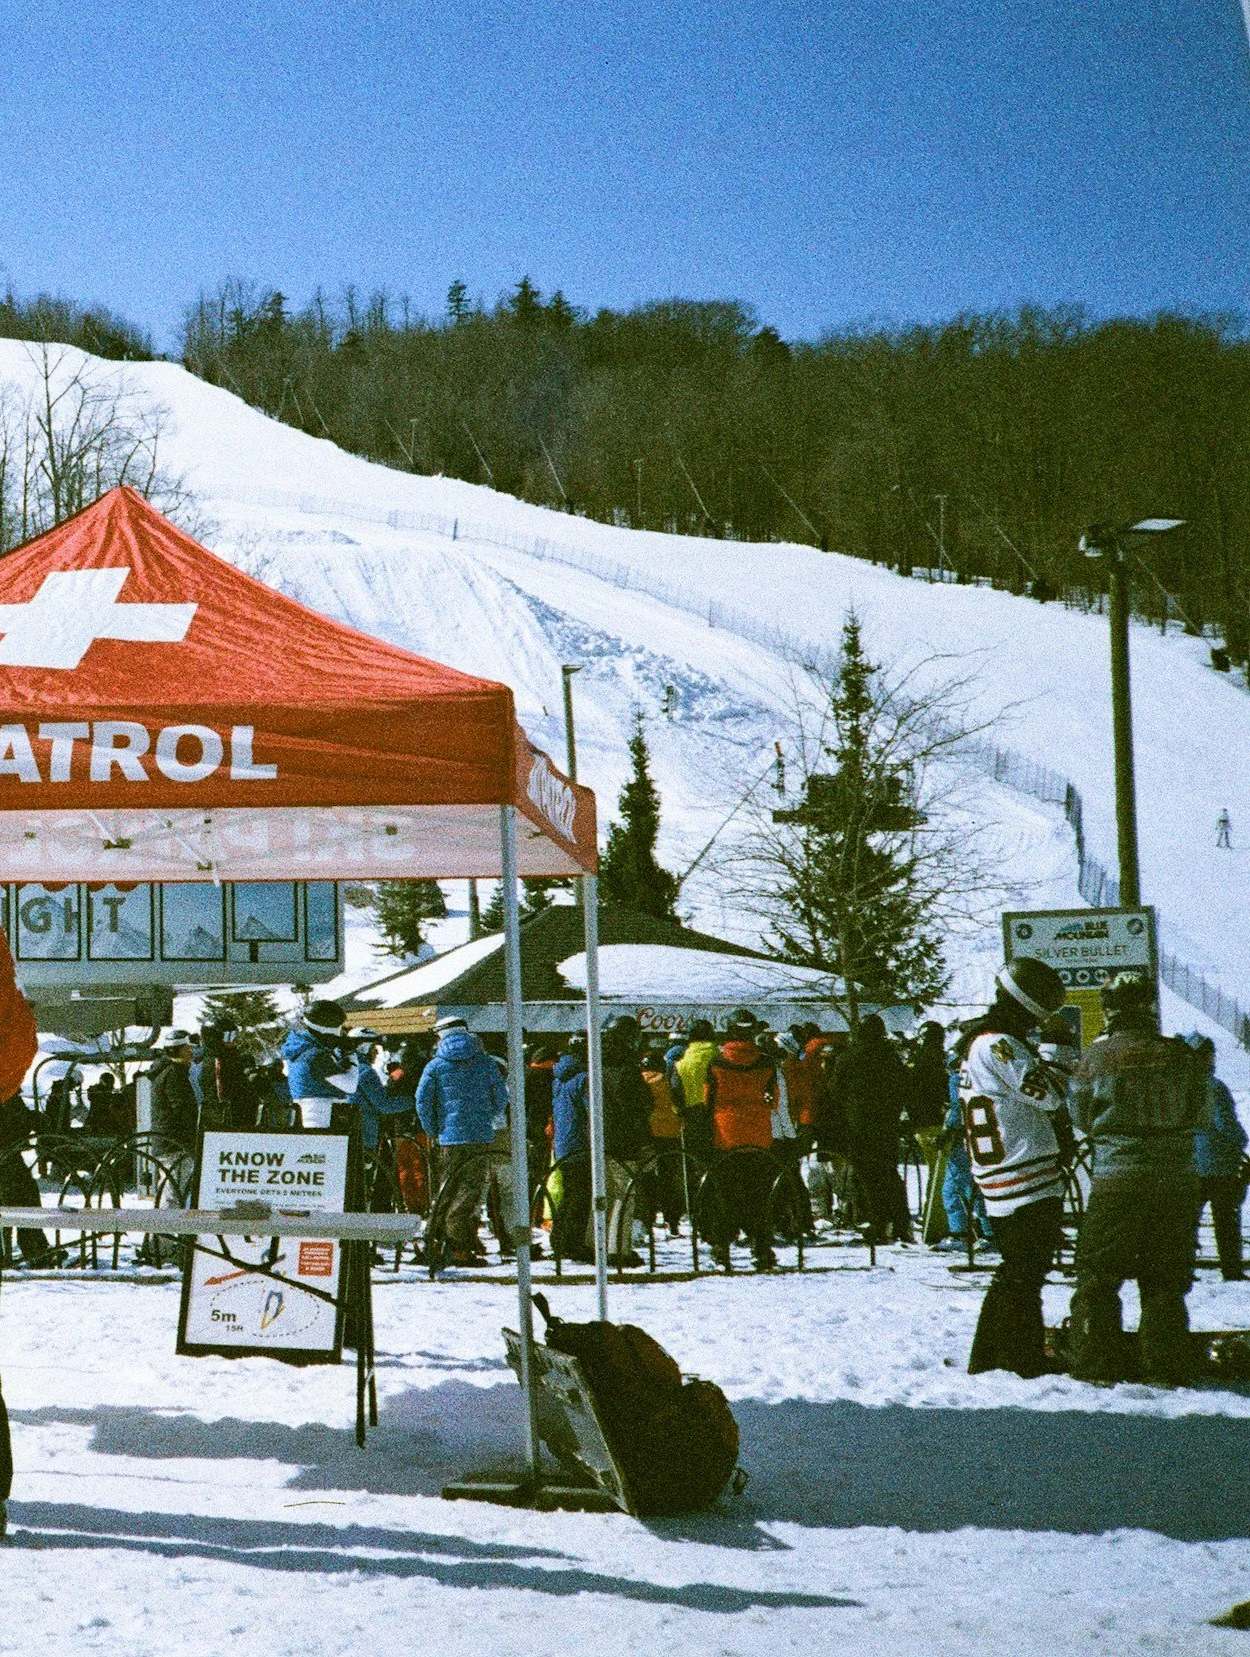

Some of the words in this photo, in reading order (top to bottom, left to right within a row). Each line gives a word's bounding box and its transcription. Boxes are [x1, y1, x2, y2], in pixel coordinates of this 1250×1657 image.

[1034, 947, 1078, 959] SILVER
[1081, 945, 1127, 957] BULLET
[218, 1151, 285, 1167] KNOW
[218, 1168, 260, 1183] THE
[266, 1170, 325, 1186] ZONE
[215, 1187, 257, 1195] EVERYONE
[211, 1309, 236, 1322] 5m
